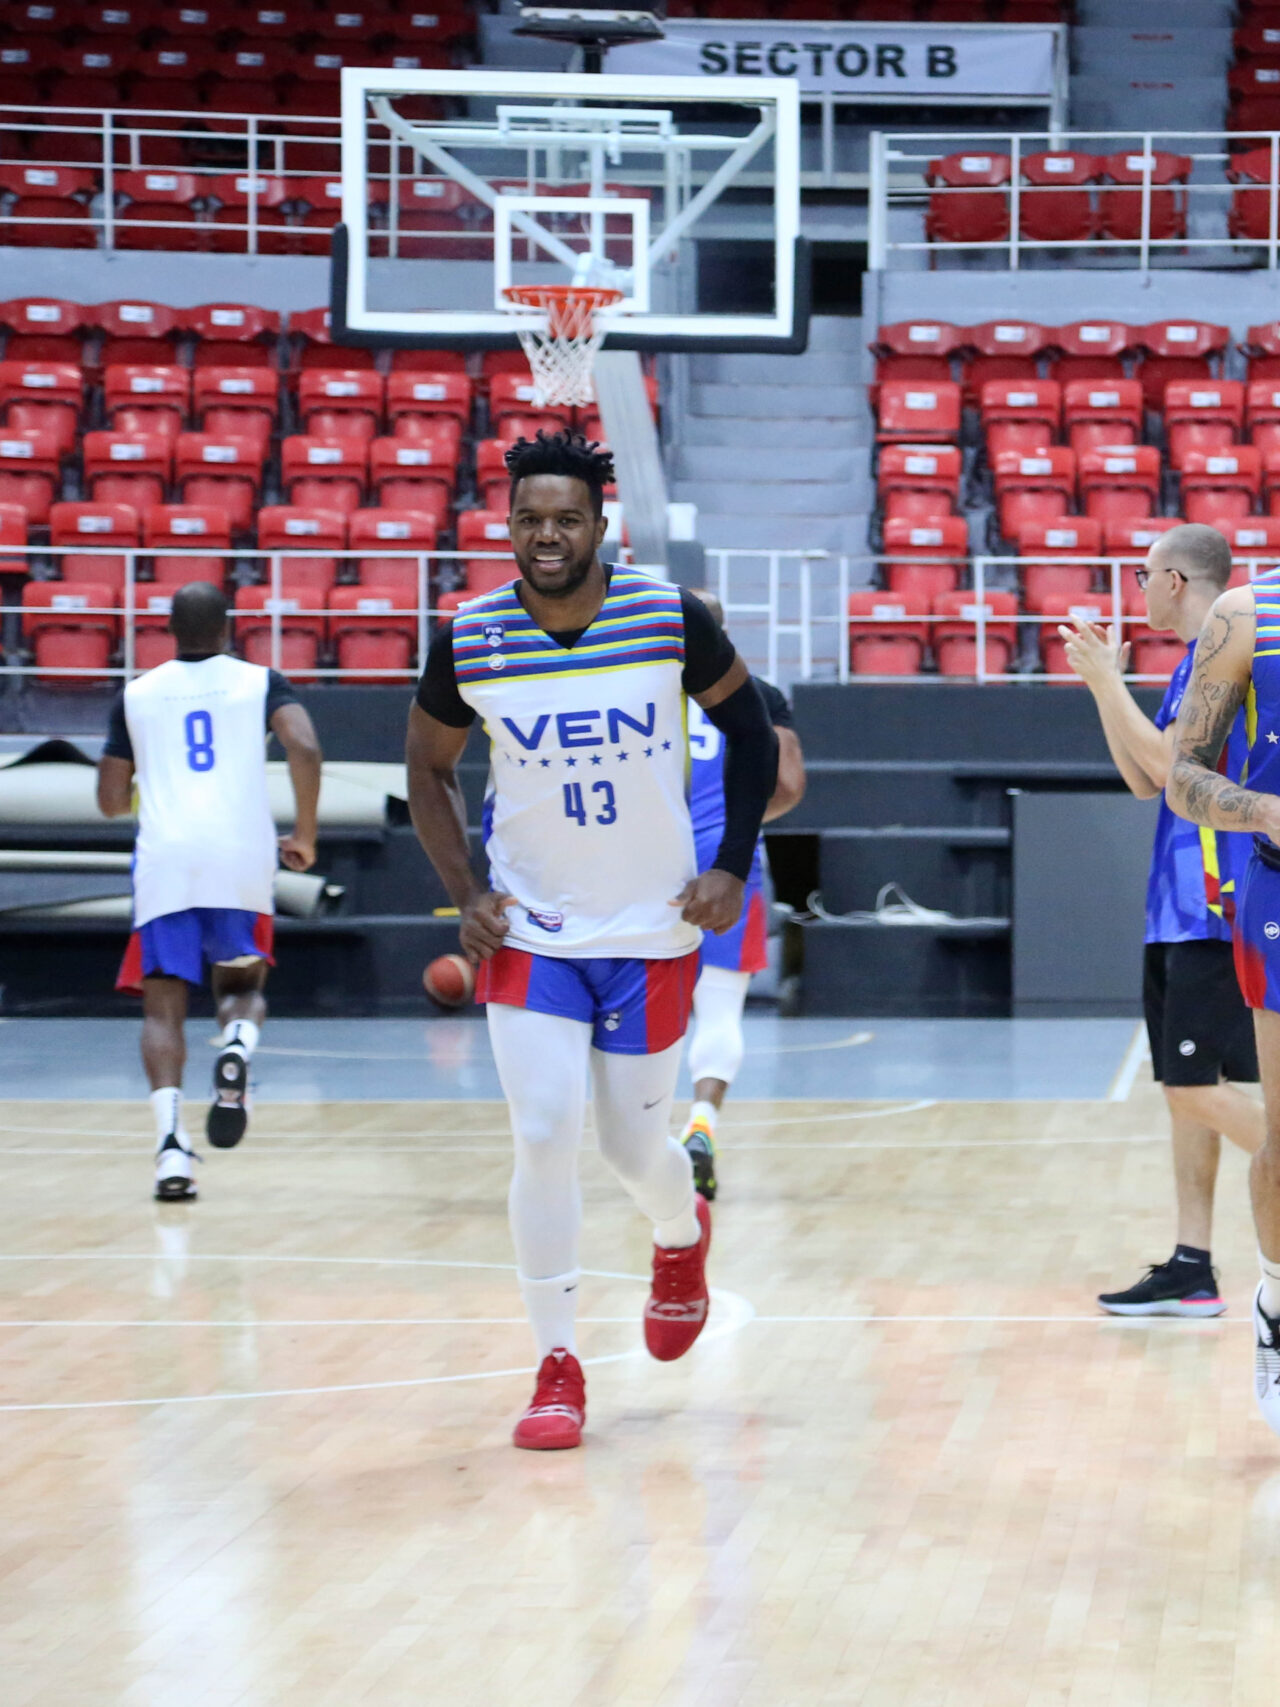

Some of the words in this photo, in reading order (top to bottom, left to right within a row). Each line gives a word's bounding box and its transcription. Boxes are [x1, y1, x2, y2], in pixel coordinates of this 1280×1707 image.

[700, 41, 906, 78] SECTOR
[927, 45, 957, 78] B
[484, 626, 501, 635] FVB
[184, 710, 214, 772] 8
[500, 702, 656, 750] VEN
[562, 780, 617, 826] 43
